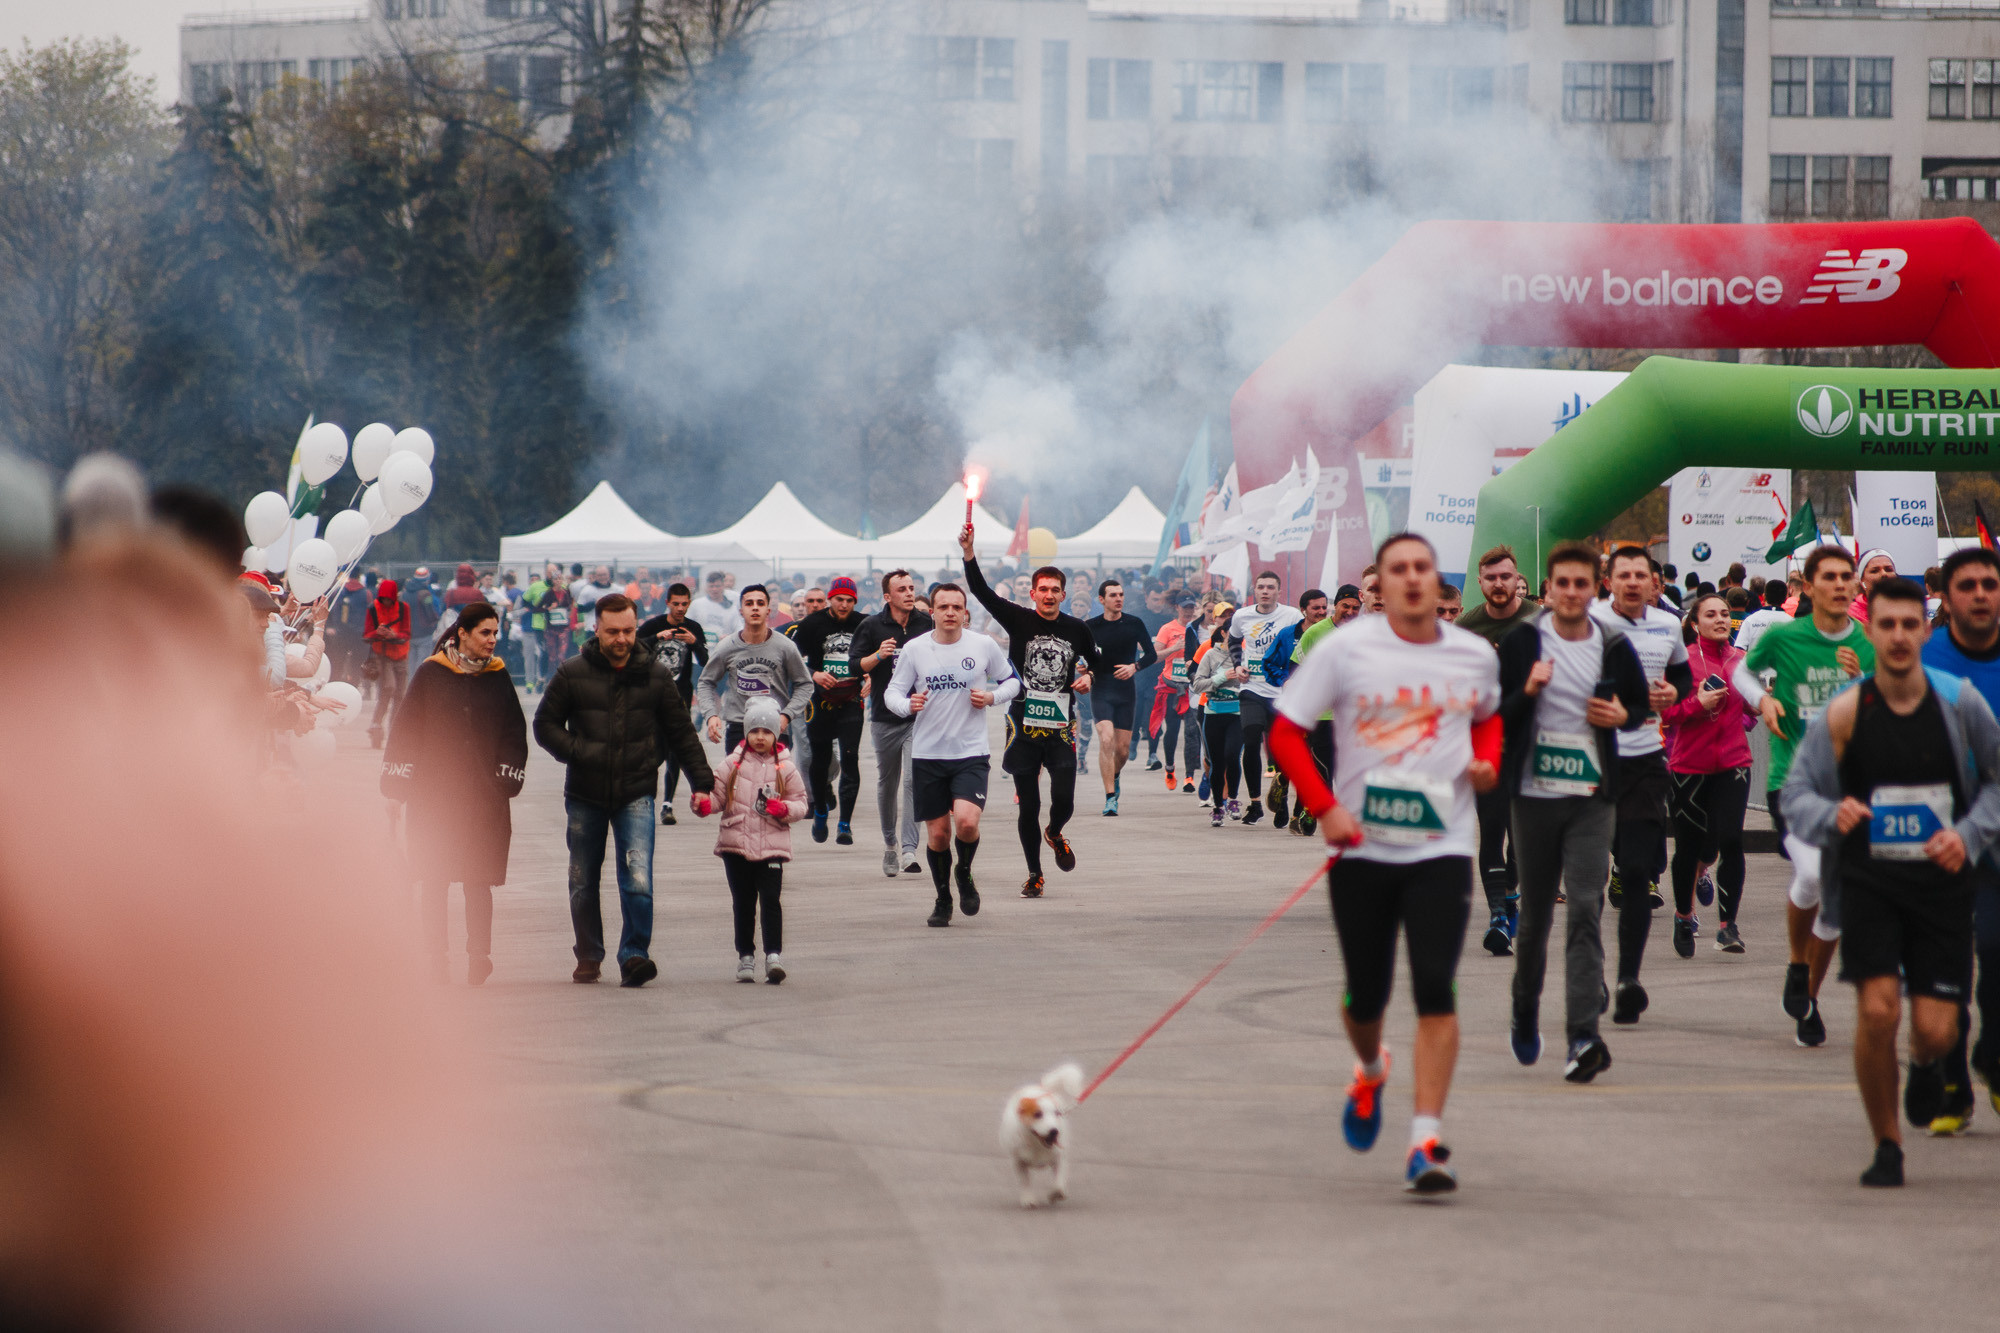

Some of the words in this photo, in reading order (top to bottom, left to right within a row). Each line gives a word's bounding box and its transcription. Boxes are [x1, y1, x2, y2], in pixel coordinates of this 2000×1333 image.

[1501, 272, 1592, 304] new
[1603, 269, 1784, 306] balance
[1859, 412, 2000, 436] NUTRIT
[1860, 441, 1937, 456] FAMILY
[1943, 441, 1989, 456] RUN
[1438, 494, 1475, 508] Твоя
[1889, 498, 1927, 510] Твоя
[1426, 510, 1475, 525] побед
[1880, 513, 1934, 528] победа
[736, 657, 755, 671] SQUAD
[756, 656, 778, 672] LEADER
[925, 674, 954, 683] RACE
[927, 681, 967, 691] NATION
[1028, 704, 1055, 717] 3051
[381, 761, 414, 779] FINE
[1539, 753, 1584, 775] 3901
[1883, 814, 1921, 837] 215
